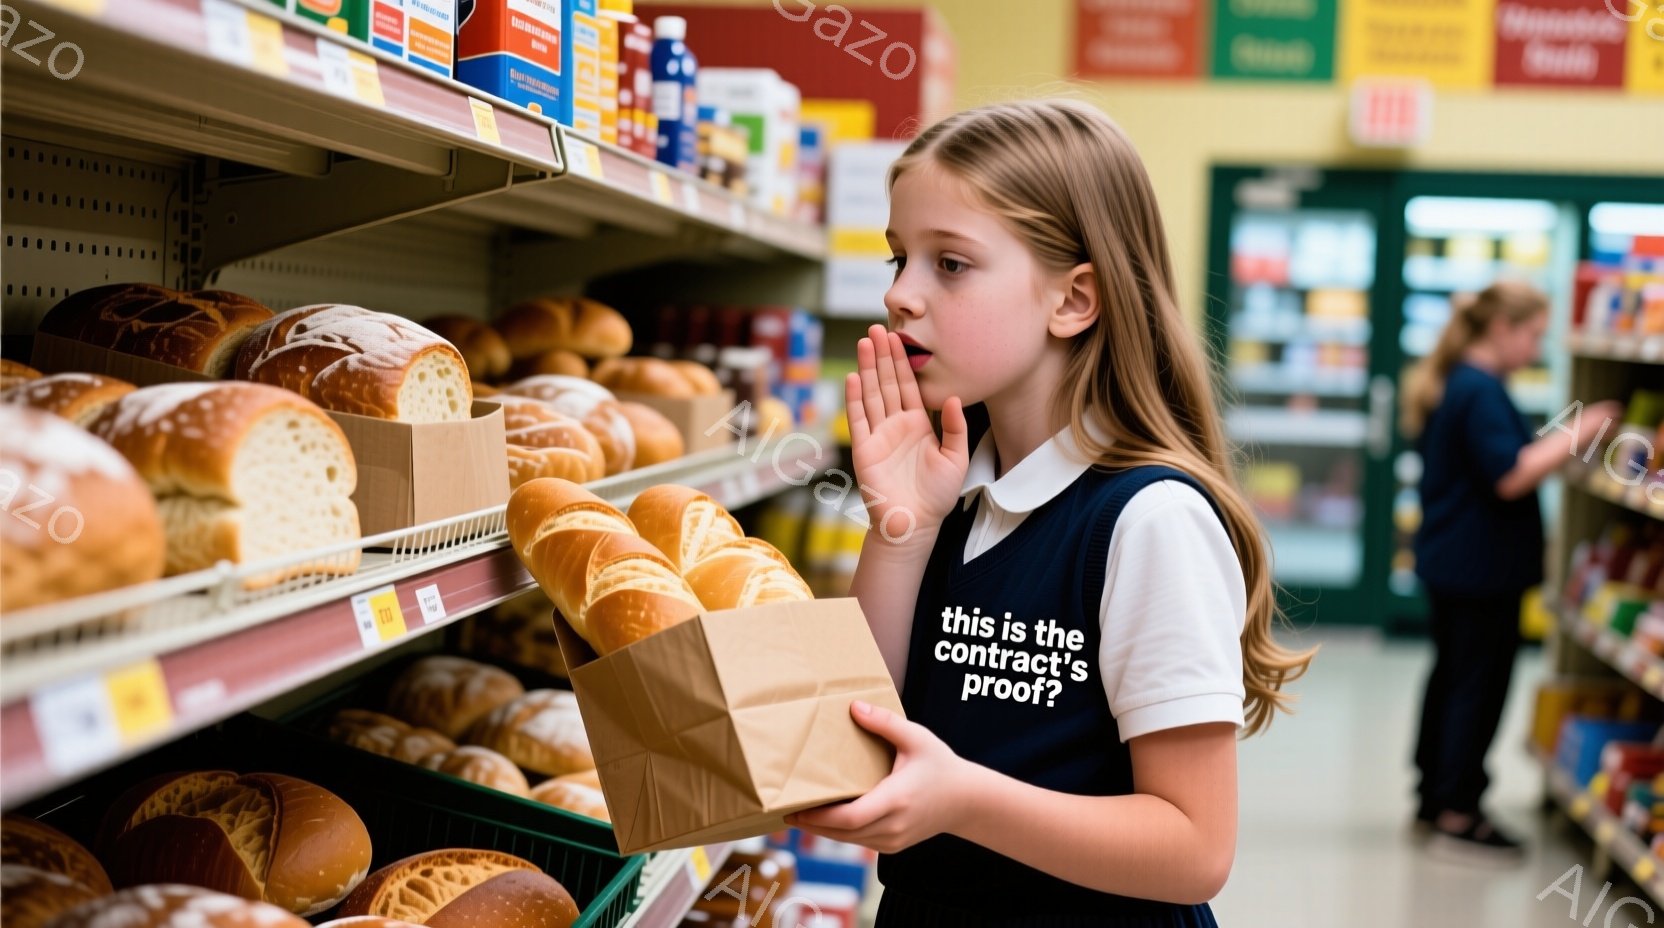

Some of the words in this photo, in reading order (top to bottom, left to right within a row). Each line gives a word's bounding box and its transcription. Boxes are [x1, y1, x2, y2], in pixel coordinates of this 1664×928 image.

[941, 606, 995, 638] this
[1001, 612, 1027, 643] is
[1034, 619, 1085, 651] the
[934, 640, 1089, 682] contract's
[961, 673, 1063, 707] proof?
